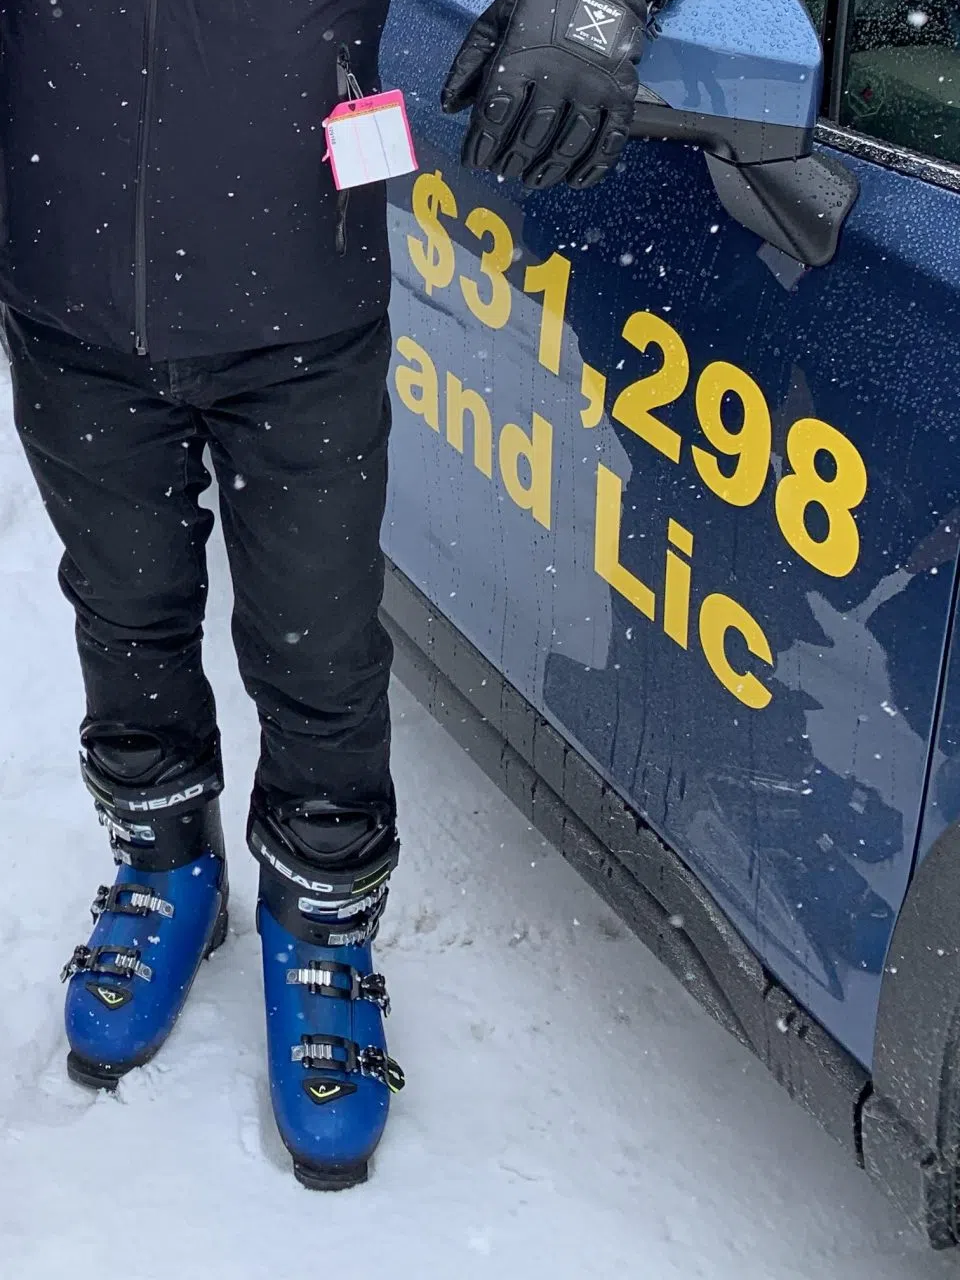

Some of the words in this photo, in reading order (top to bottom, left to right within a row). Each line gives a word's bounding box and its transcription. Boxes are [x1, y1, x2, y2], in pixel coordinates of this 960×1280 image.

[406, 170, 868, 578] $31,298
[395, 336, 553, 531] and
[594, 462, 774, 709] Lic
[128, 783, 205, 812] HEAD
[260, 844, 333, 893] HEAD
